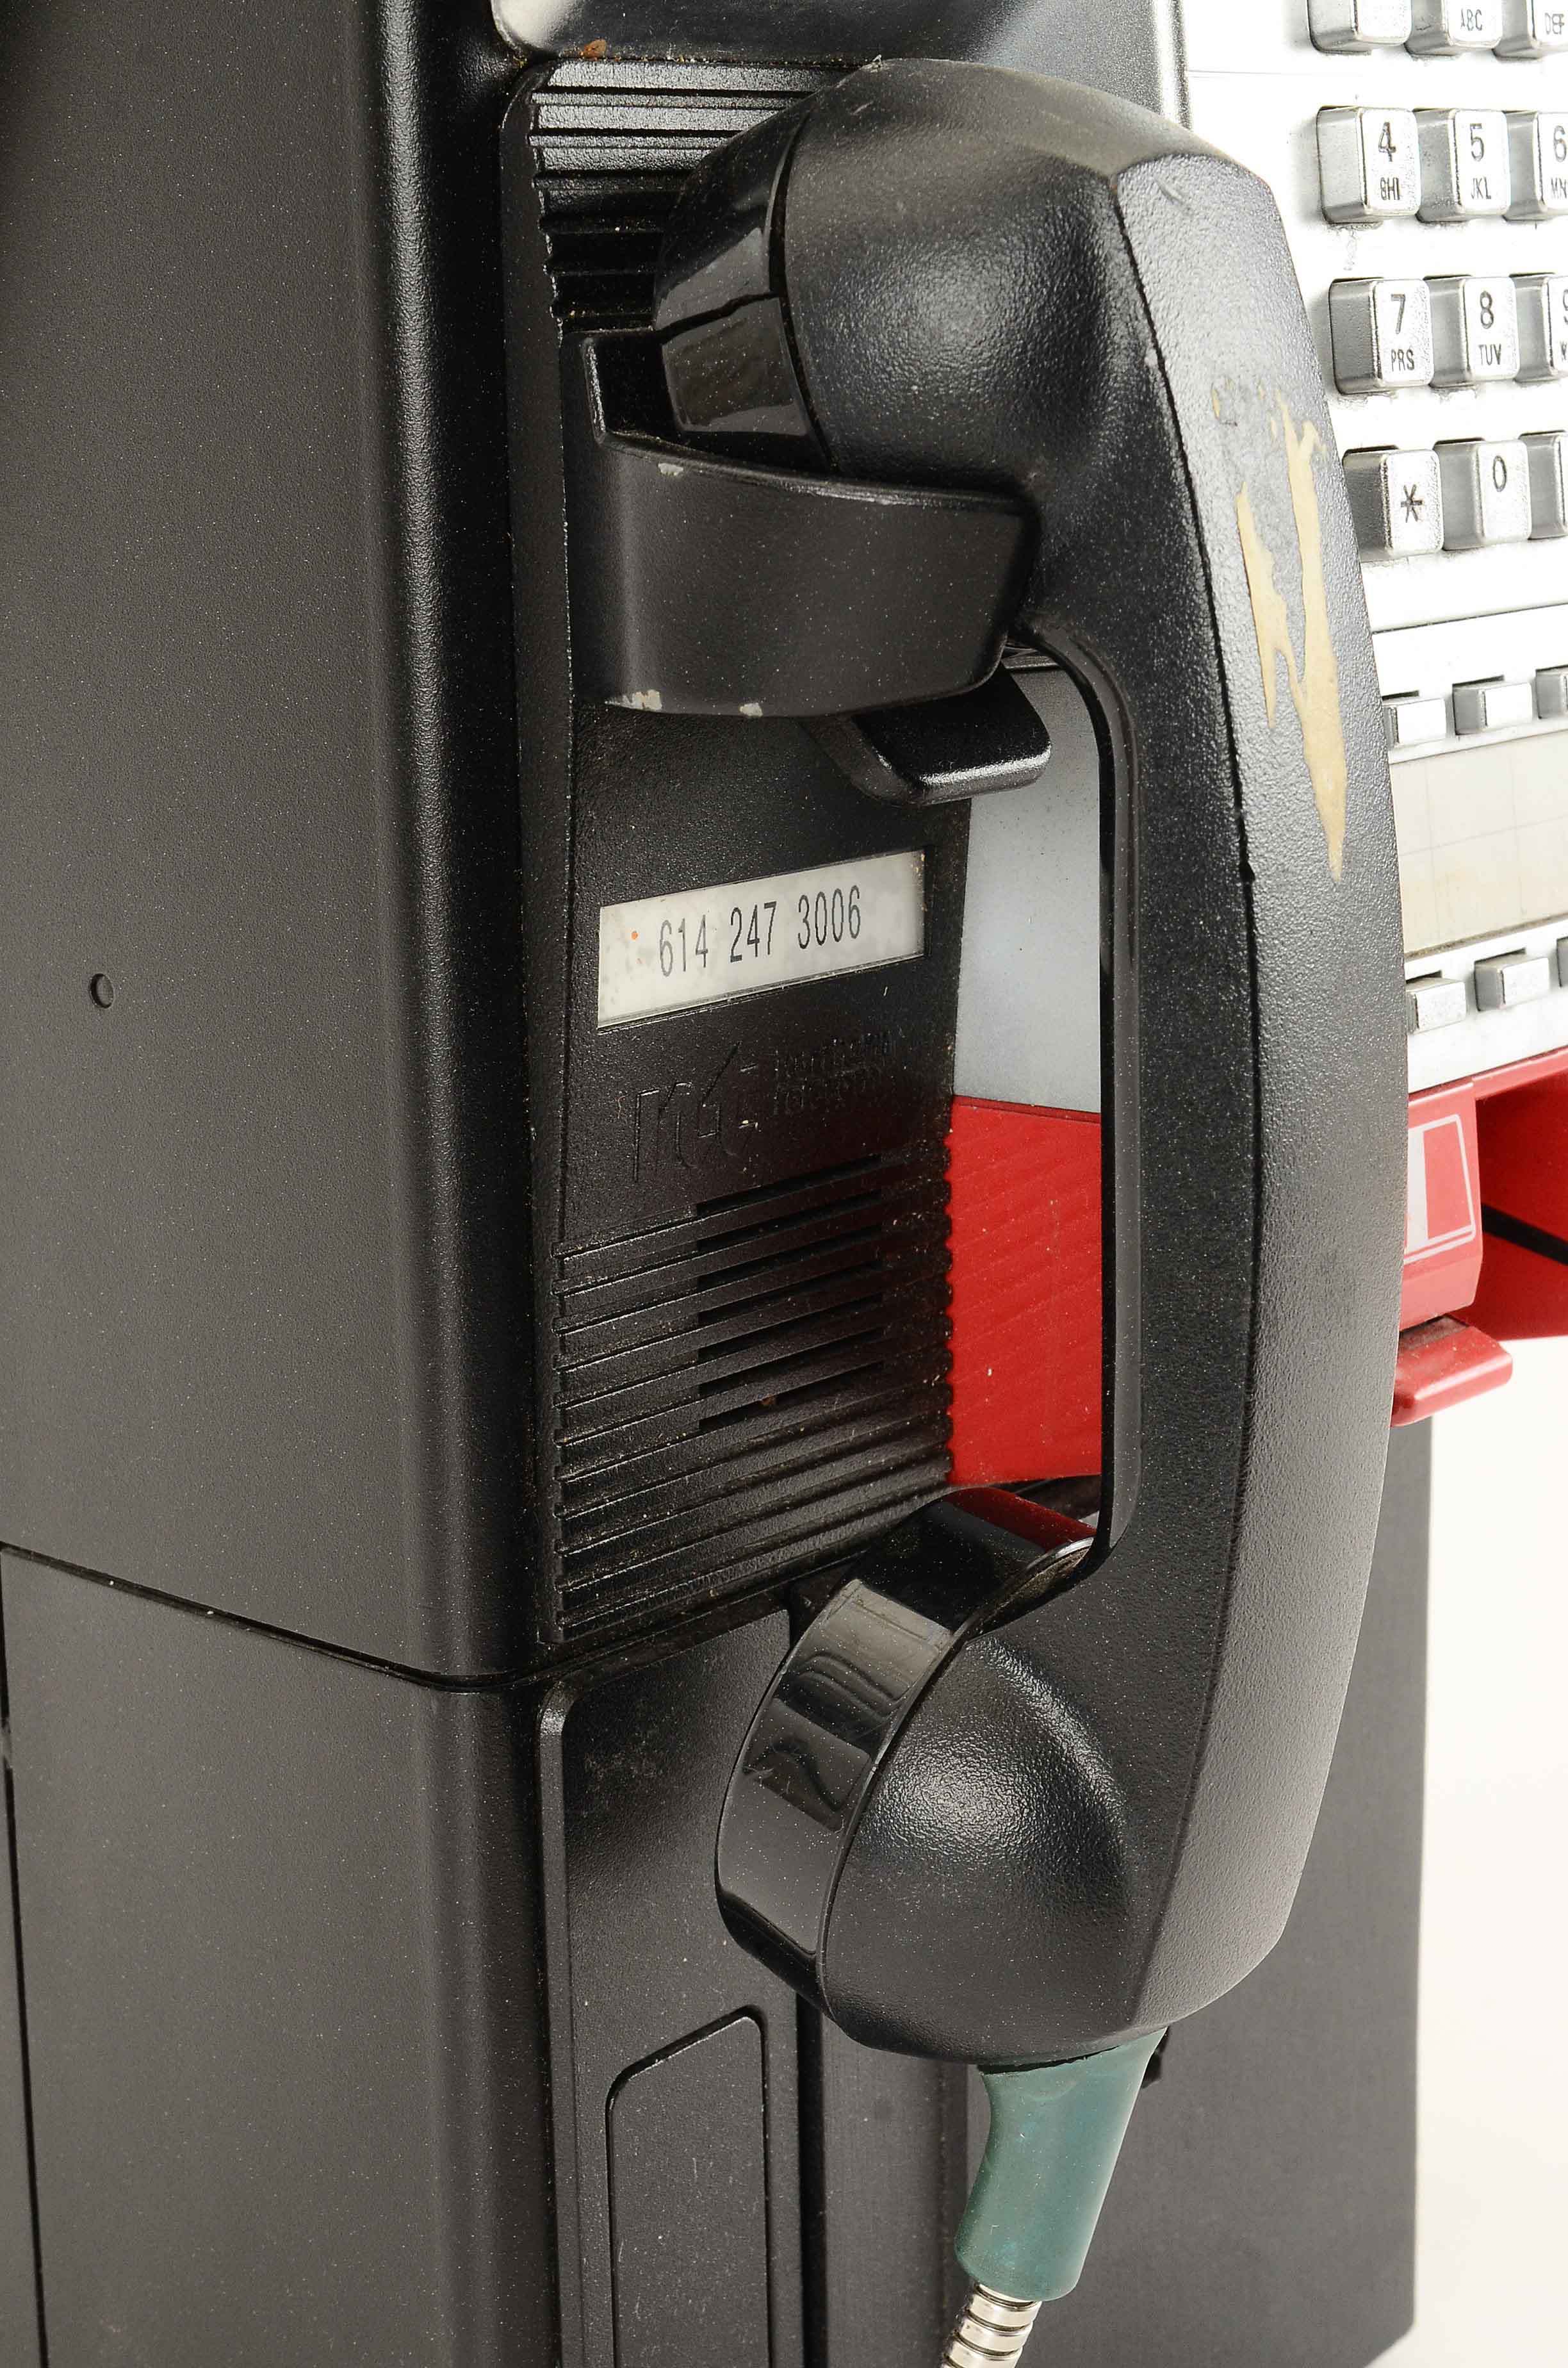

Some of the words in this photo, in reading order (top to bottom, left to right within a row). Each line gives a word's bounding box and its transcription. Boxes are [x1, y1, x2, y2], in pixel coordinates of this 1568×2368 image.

[1460, 8, 1483, 31] ABC
[1544, 12, 1565, 35] DEF
[1378, 122, 1397, 162] 4
[1469, 122, 1485, 162] 5
[1553, 125, 1567, 163] 6
[1470, 177, 1492, 201] JKL
[1551, 177, 1568, 199] MN
[1391, 293, 1406, 334] 7
[1480, 290, 1494, 329] 8
[1391, 349, 1415, 372] PRS
[1478, 343, 1502, 366] TUV
[660, 914, 708, 977] 614
[730, 901, 777, 963] 247
[797, 885, 862, 949] 3006
